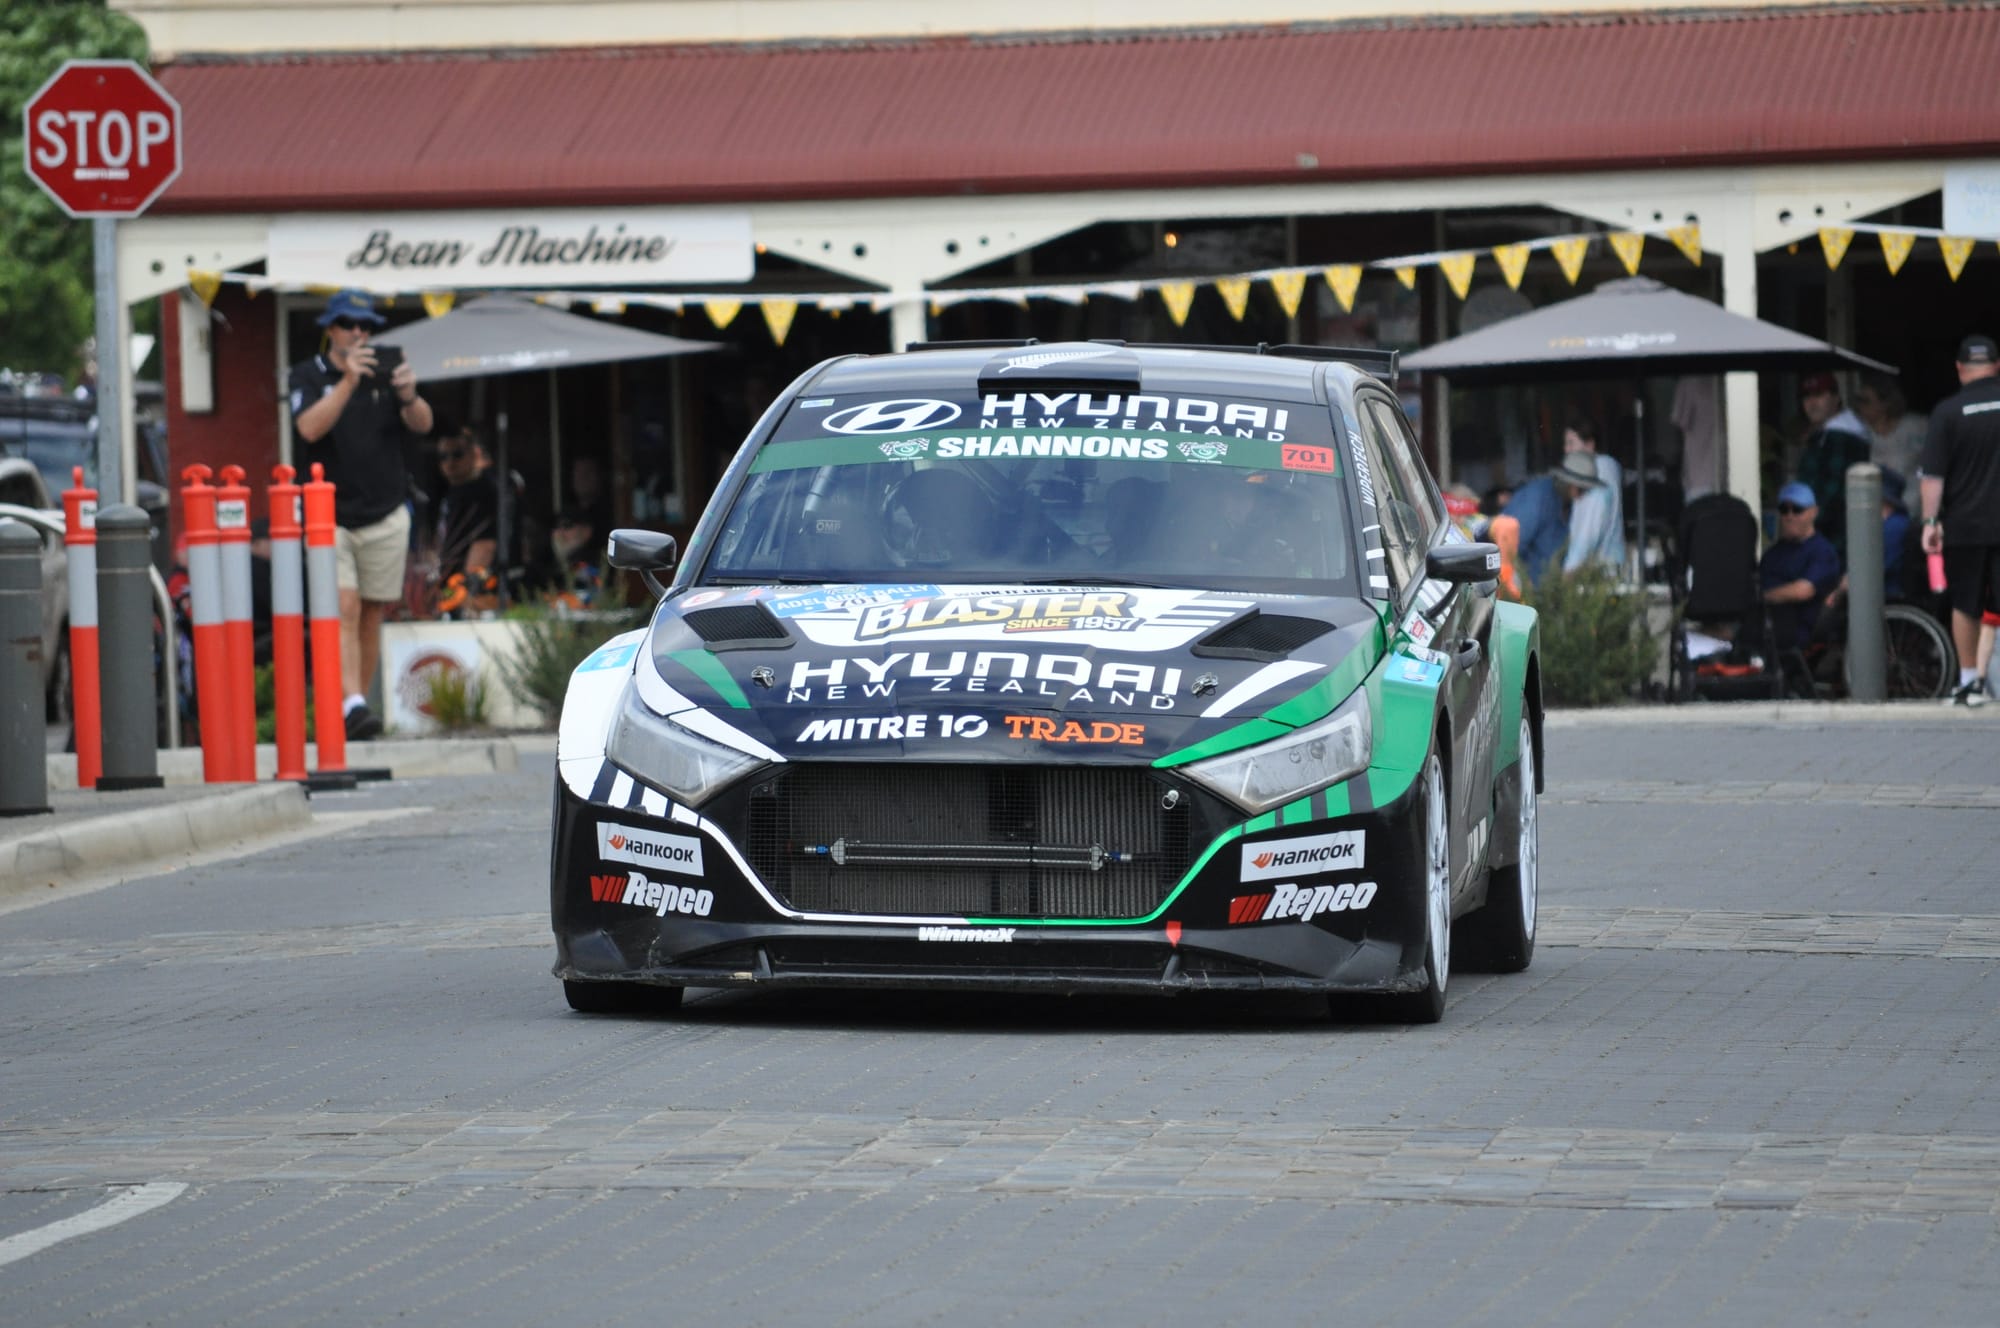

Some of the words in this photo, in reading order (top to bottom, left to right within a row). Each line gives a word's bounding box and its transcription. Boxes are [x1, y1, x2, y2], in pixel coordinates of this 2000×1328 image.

[35, 110, 171, 168] STOP
[347, 229, 472, 269] Bean
[478, 223, 676, 266] Machine
[980, 417, 1065, 429] NEW
[1093, 418, 1285, 442] ZEALAND
[982, 393, 1288, 431] HYUNDAI
[935, 435, 1169, 459] SHANNONS
[1284, 449, 1327, 464] 701
[1348, 430, 1376, 508] WIPERTECH
[875, 584, 930, 600] RALLY
[859, 592, 1128, 638] BLASTER
[1006, 617, 1069, 630] SINCE
[1072, 617, 1140, 630] 1957
[790, 651, 1182, 696] HYUNDAI
[787, 679, 897, 703] NEW
[931, 677, 1175, 710] ZEALAND
[796, 714, 928, 742] MITRE
[938, 714, 989, 738] 10
[1004, 715, 1145, 745] TRADE
[621, 871, 714, 917] Repco
[1261, 882, 1378, 922] Repco
